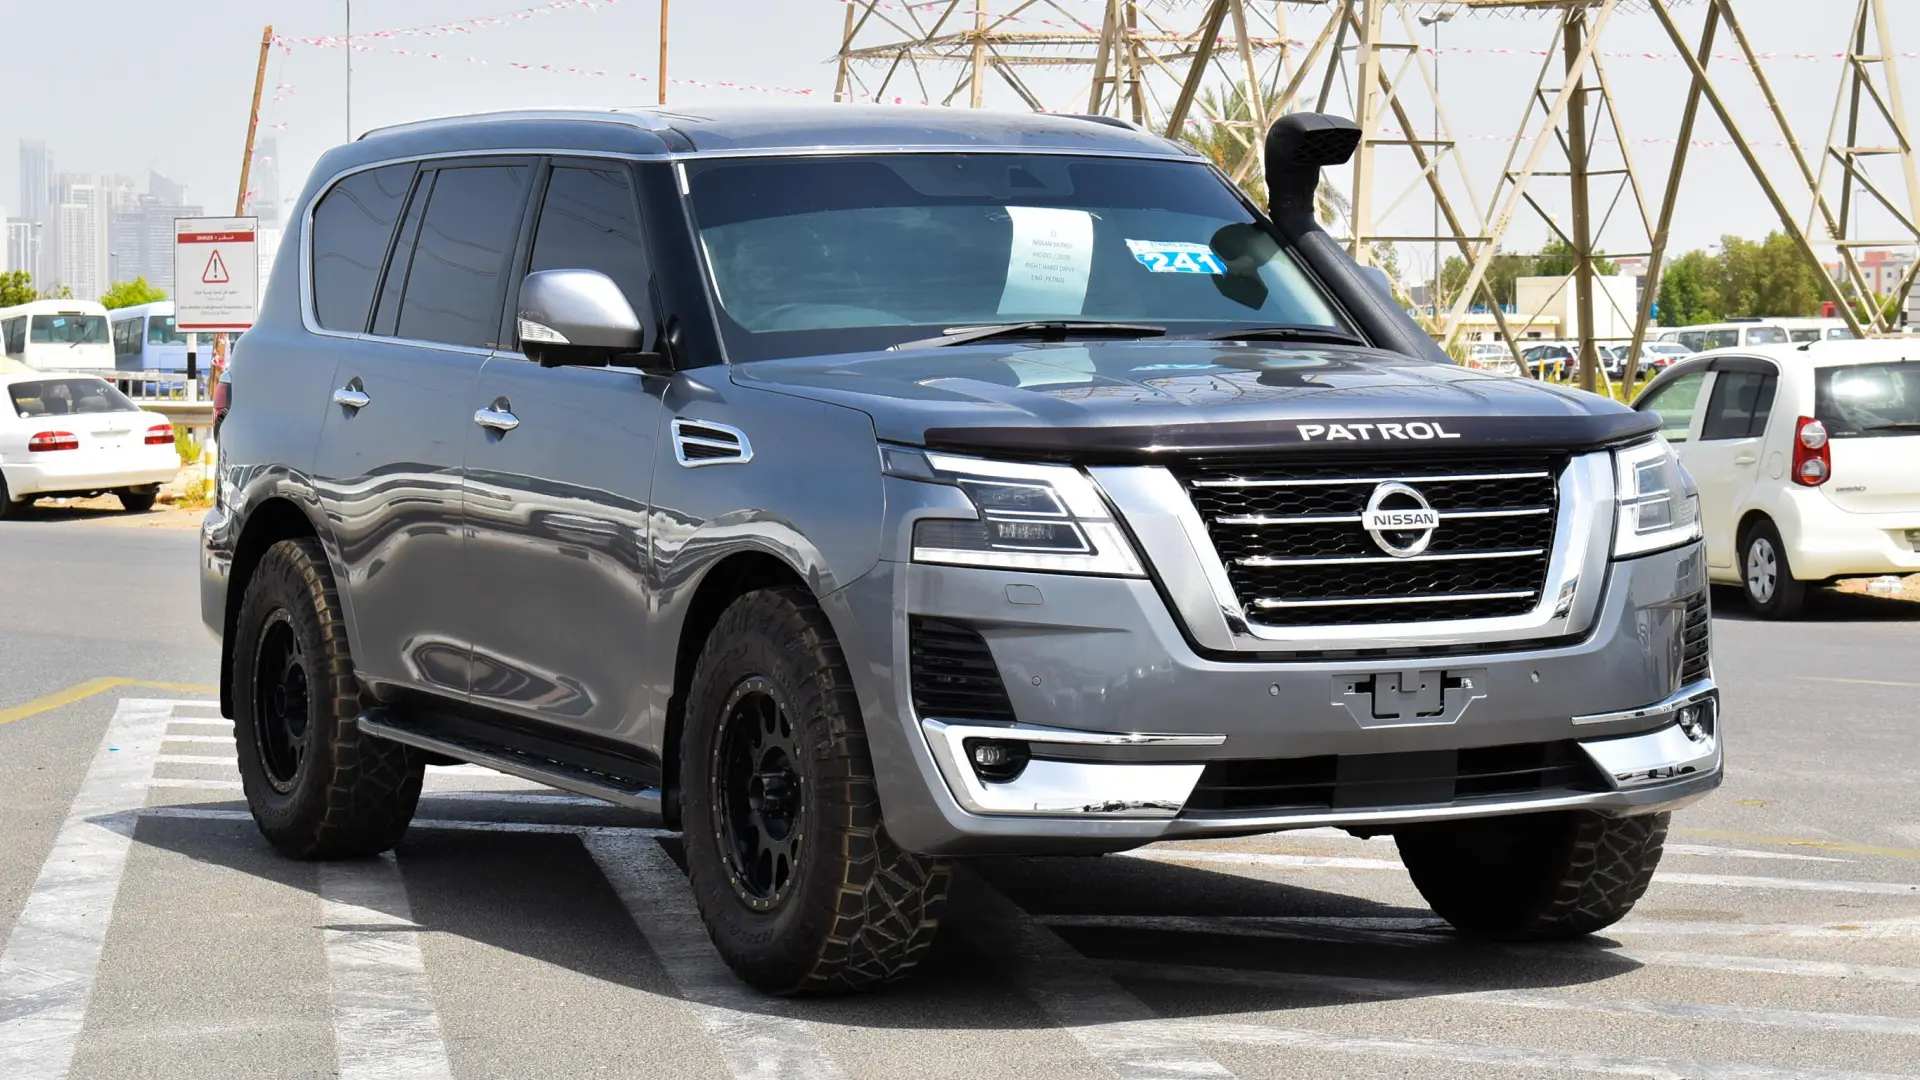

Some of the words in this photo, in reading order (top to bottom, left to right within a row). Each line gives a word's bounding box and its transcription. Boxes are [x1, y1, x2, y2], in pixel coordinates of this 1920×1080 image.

[1032, 239, 1052, 247] NISSAN
[1033, 251, 1052, 260] MODEL
[1025, 262, 1040, 270] RIGHT
[1042, 264, 1058, 272] HAND
[1059, 265, 1075, 273] DRIVE
[1144, 252, 1222, 274] 241
[1045, 275, 1065, 283] PETROL
[1296, 422, 1461, 441] PATROL
[1373, 514, 1434, 526] NISSAN
